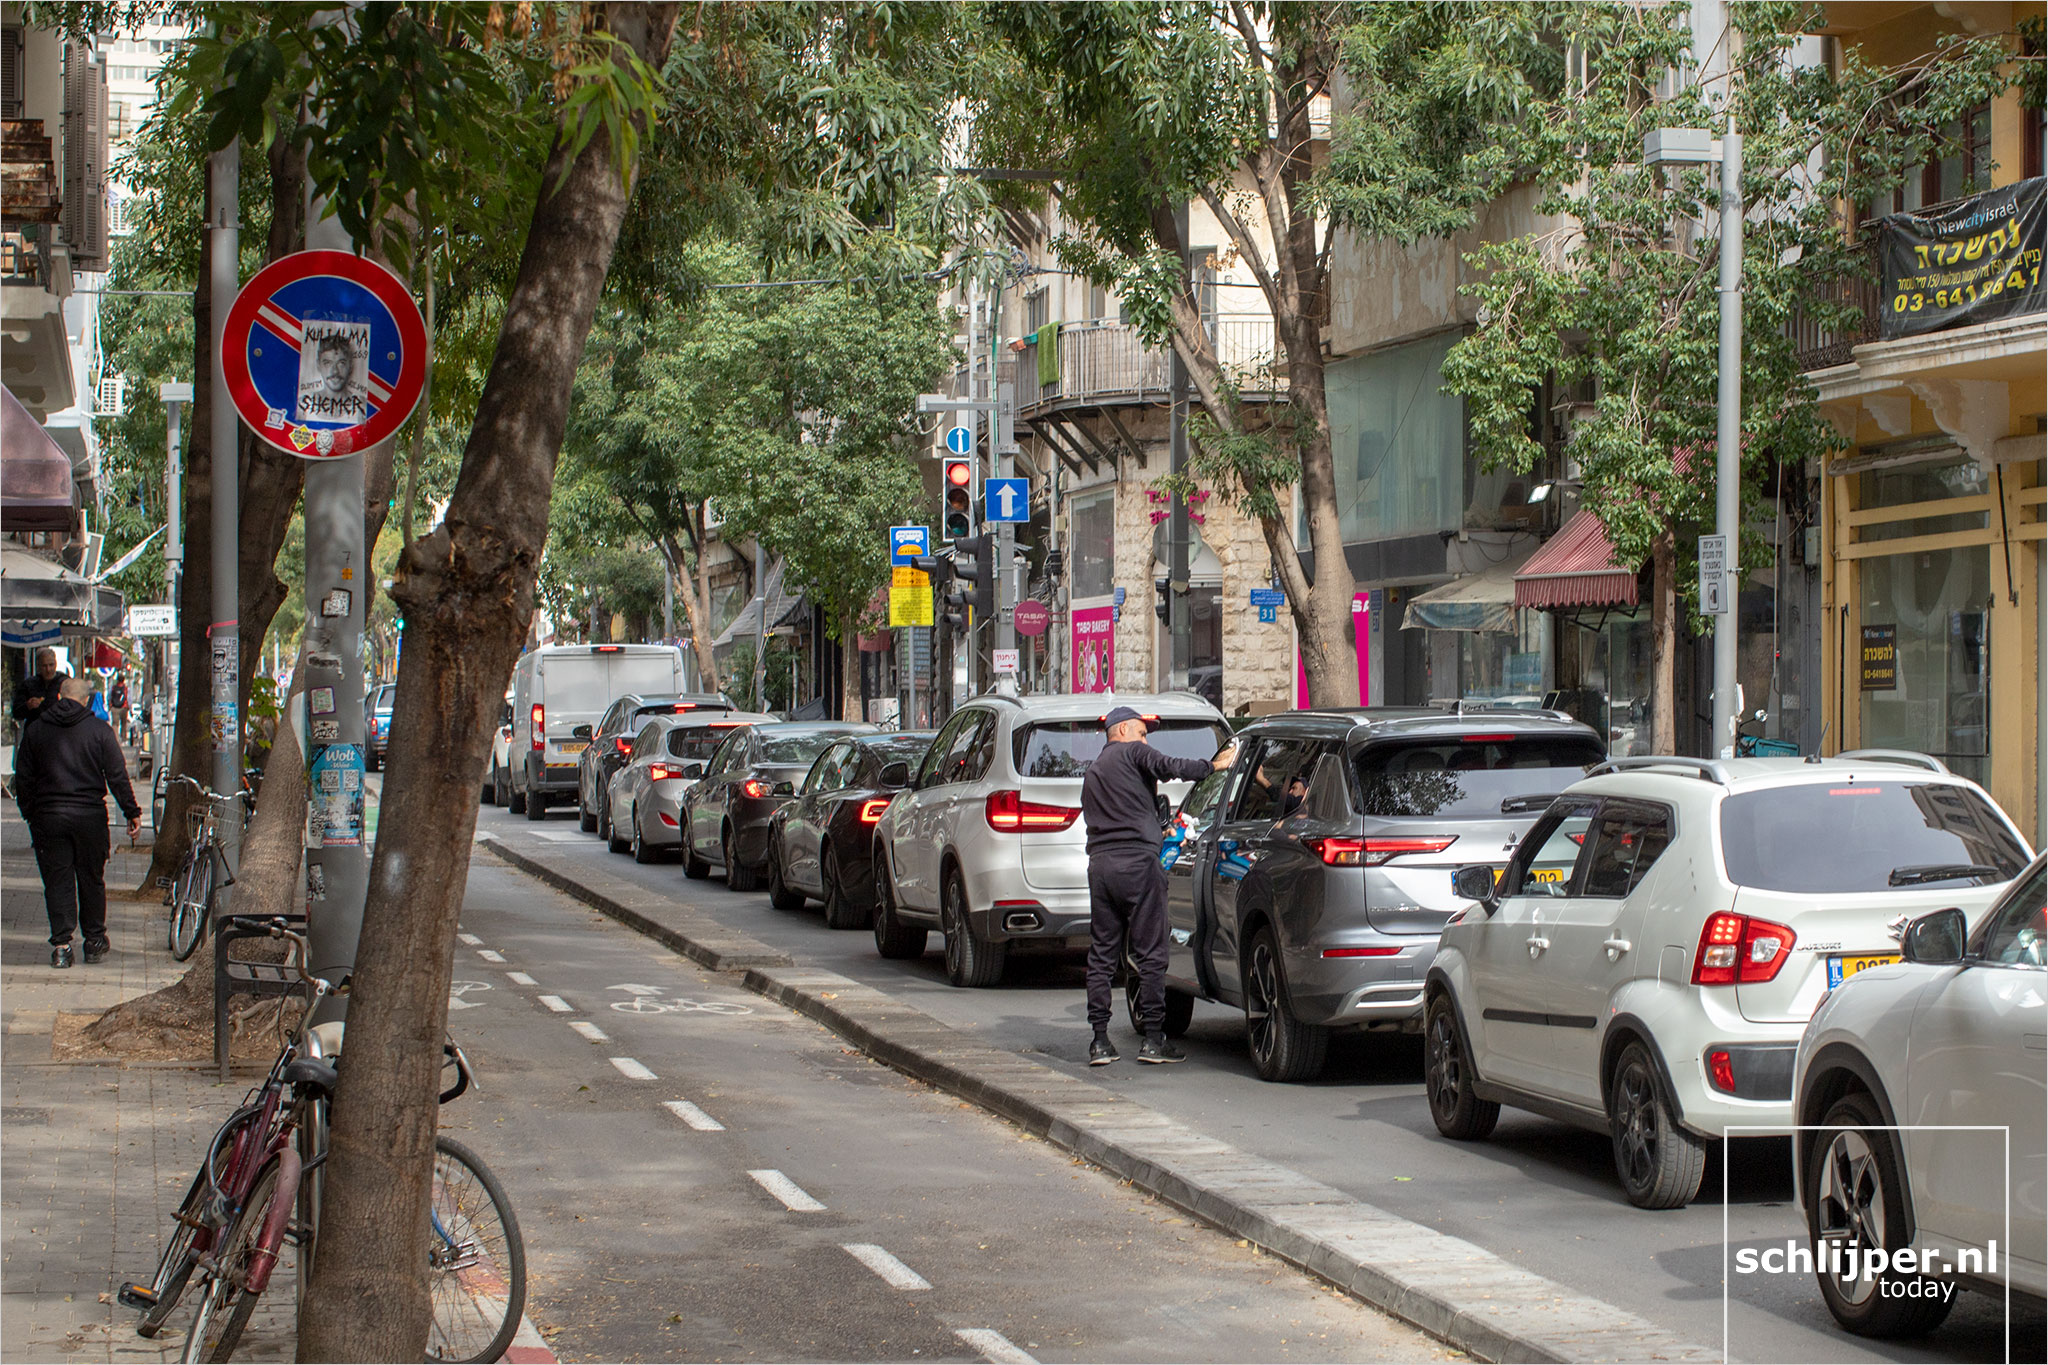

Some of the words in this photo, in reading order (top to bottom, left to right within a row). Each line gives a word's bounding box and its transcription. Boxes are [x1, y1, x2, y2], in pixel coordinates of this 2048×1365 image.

[1936, 198, 2019, 235] Newcityisrael
[1914, 218, 2021, 270] להשכרה
[1893, 267, 2040, 313] 03-6418641
[299, 394, 366, 416] SHEMER
[1261, 609, 1275, 620] 31
[1091, 619, 1110, 633] BAKERY
[1864, 643, 1893, 661] להשכרה
[326, 749, 356, 762] Wolt
